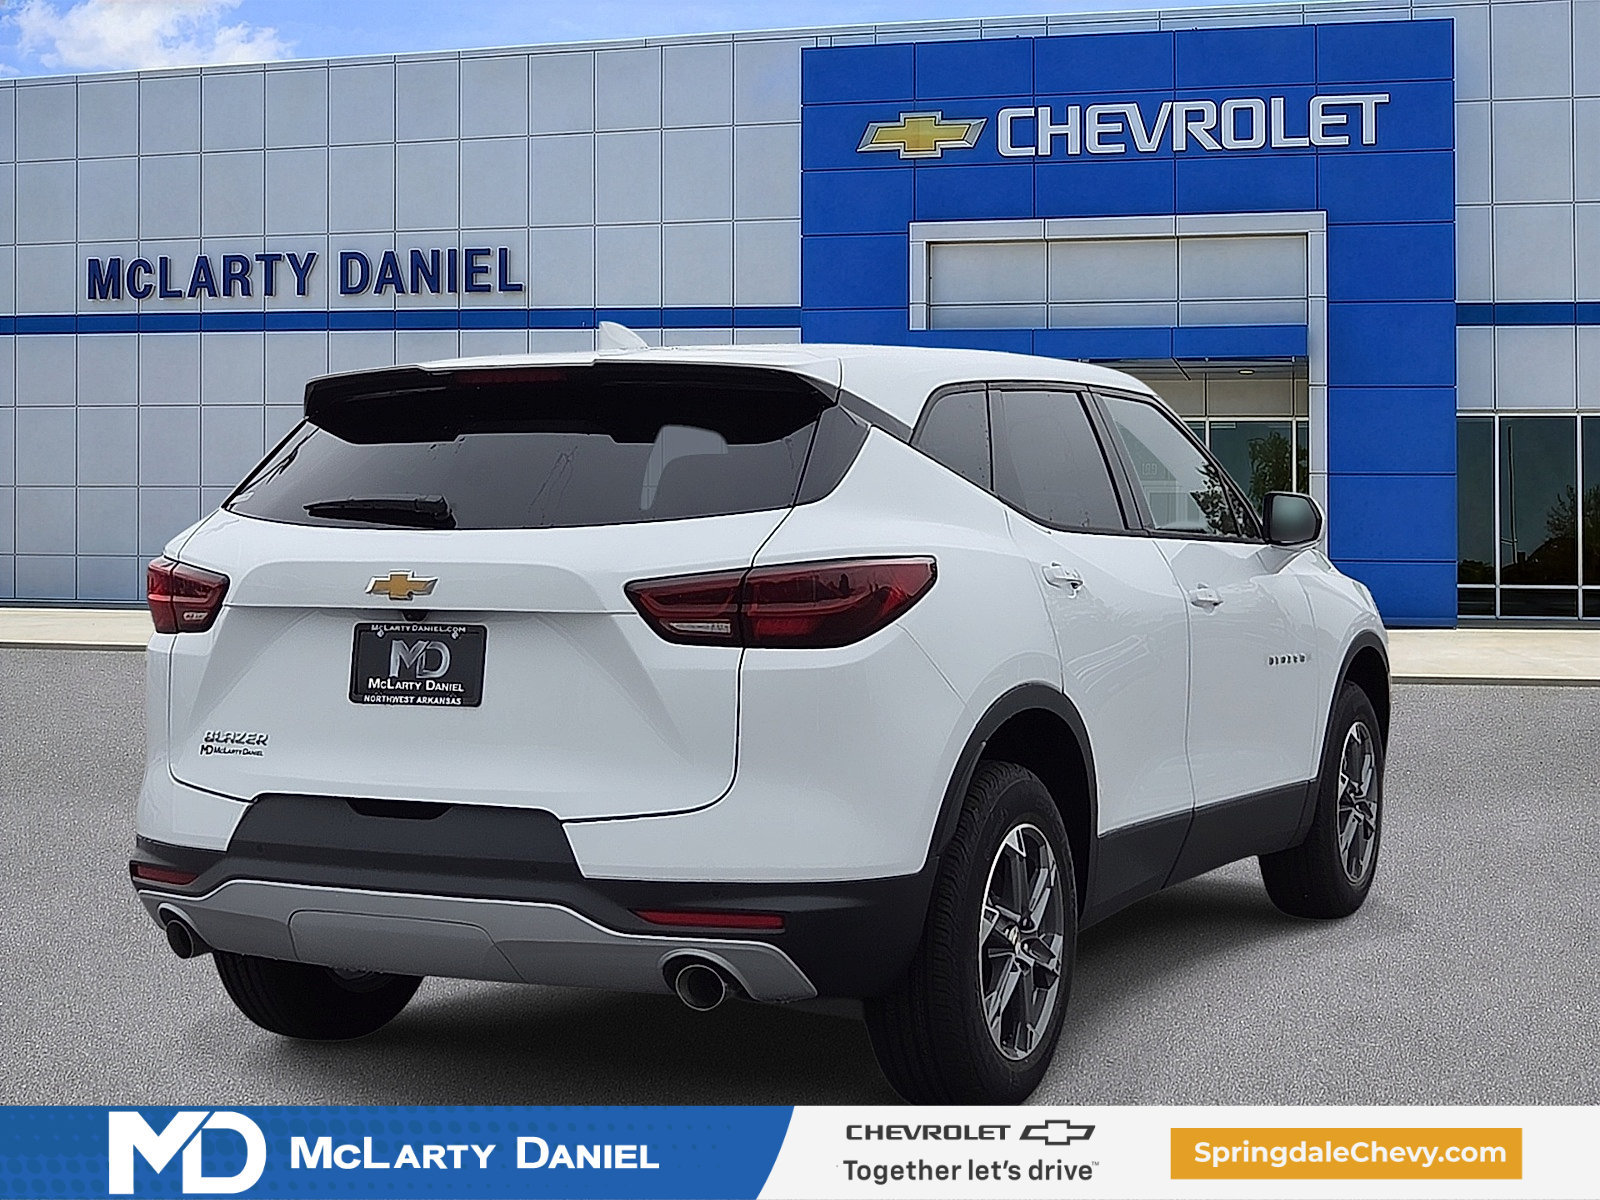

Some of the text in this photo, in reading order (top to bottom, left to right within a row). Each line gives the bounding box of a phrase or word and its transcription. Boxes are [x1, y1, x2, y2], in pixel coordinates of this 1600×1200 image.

[997, 93, 1389, 158] CHEVROLET
[338, 246, 525, 296] DANIEL
[425, 680, 464, 692] DANIEL
[364, 694, 461, 705] NORTHWEST ARKANSAS
[204, 731, 269, 746] BLAZER
